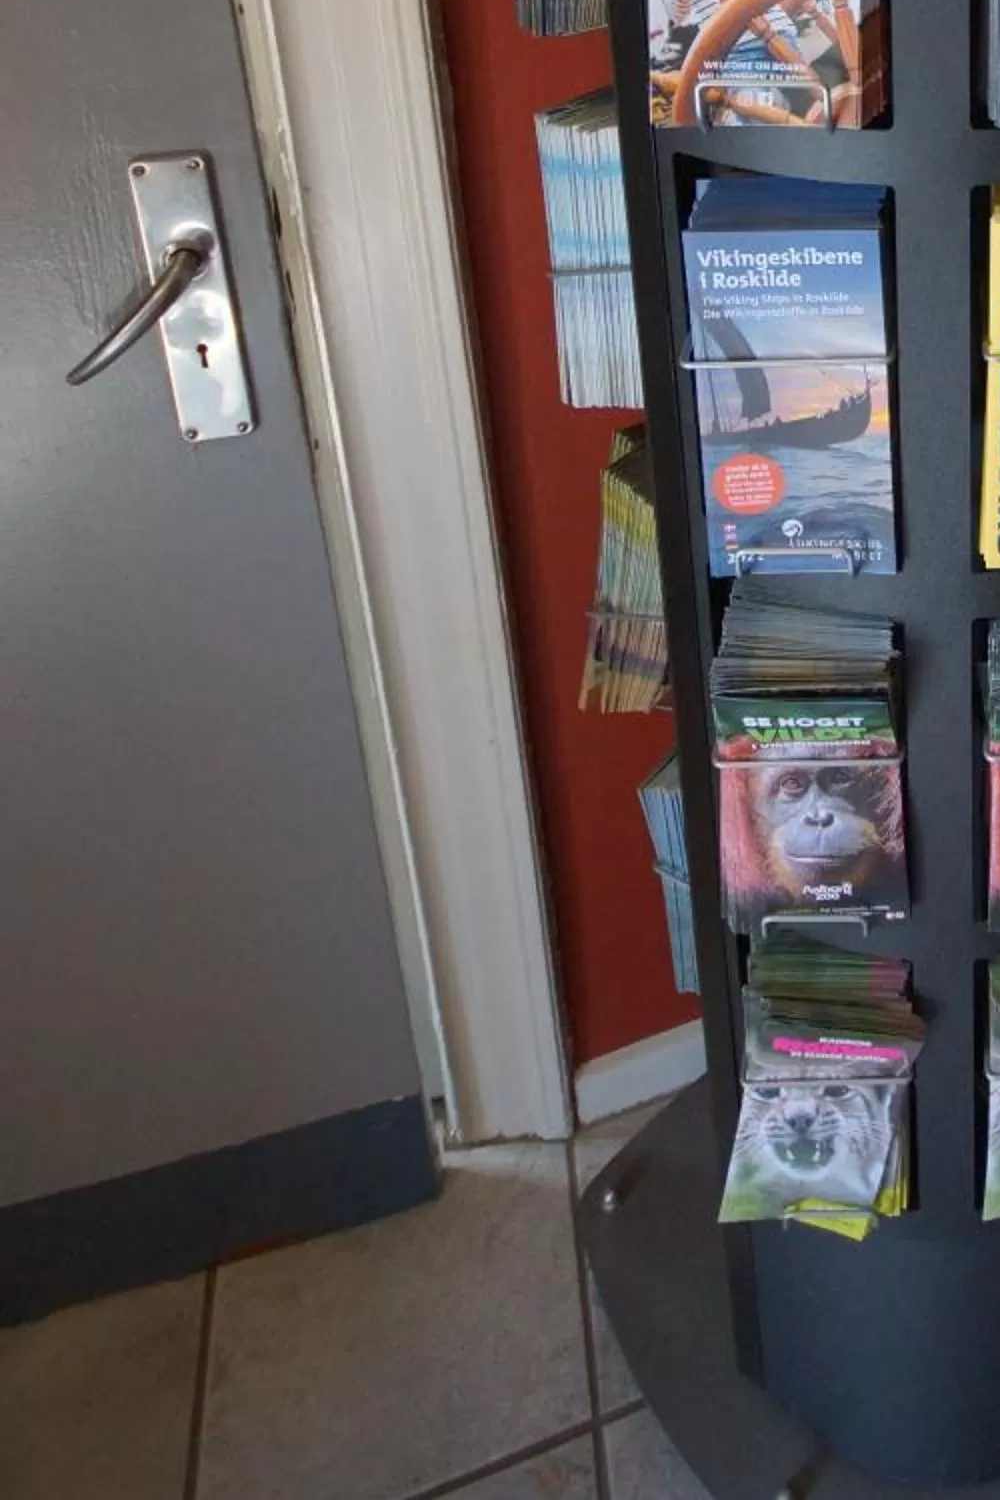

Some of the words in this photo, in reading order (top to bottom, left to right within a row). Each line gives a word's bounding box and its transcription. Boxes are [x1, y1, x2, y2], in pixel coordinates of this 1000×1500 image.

[697, 248, 863, 270] Vikingeskibene
[700, 272, 707, 288] i
[713, 270, 801, 288] Roskilde
[743, 717, 771, 727] SE
[778, 717, 864, 728] NOGET
